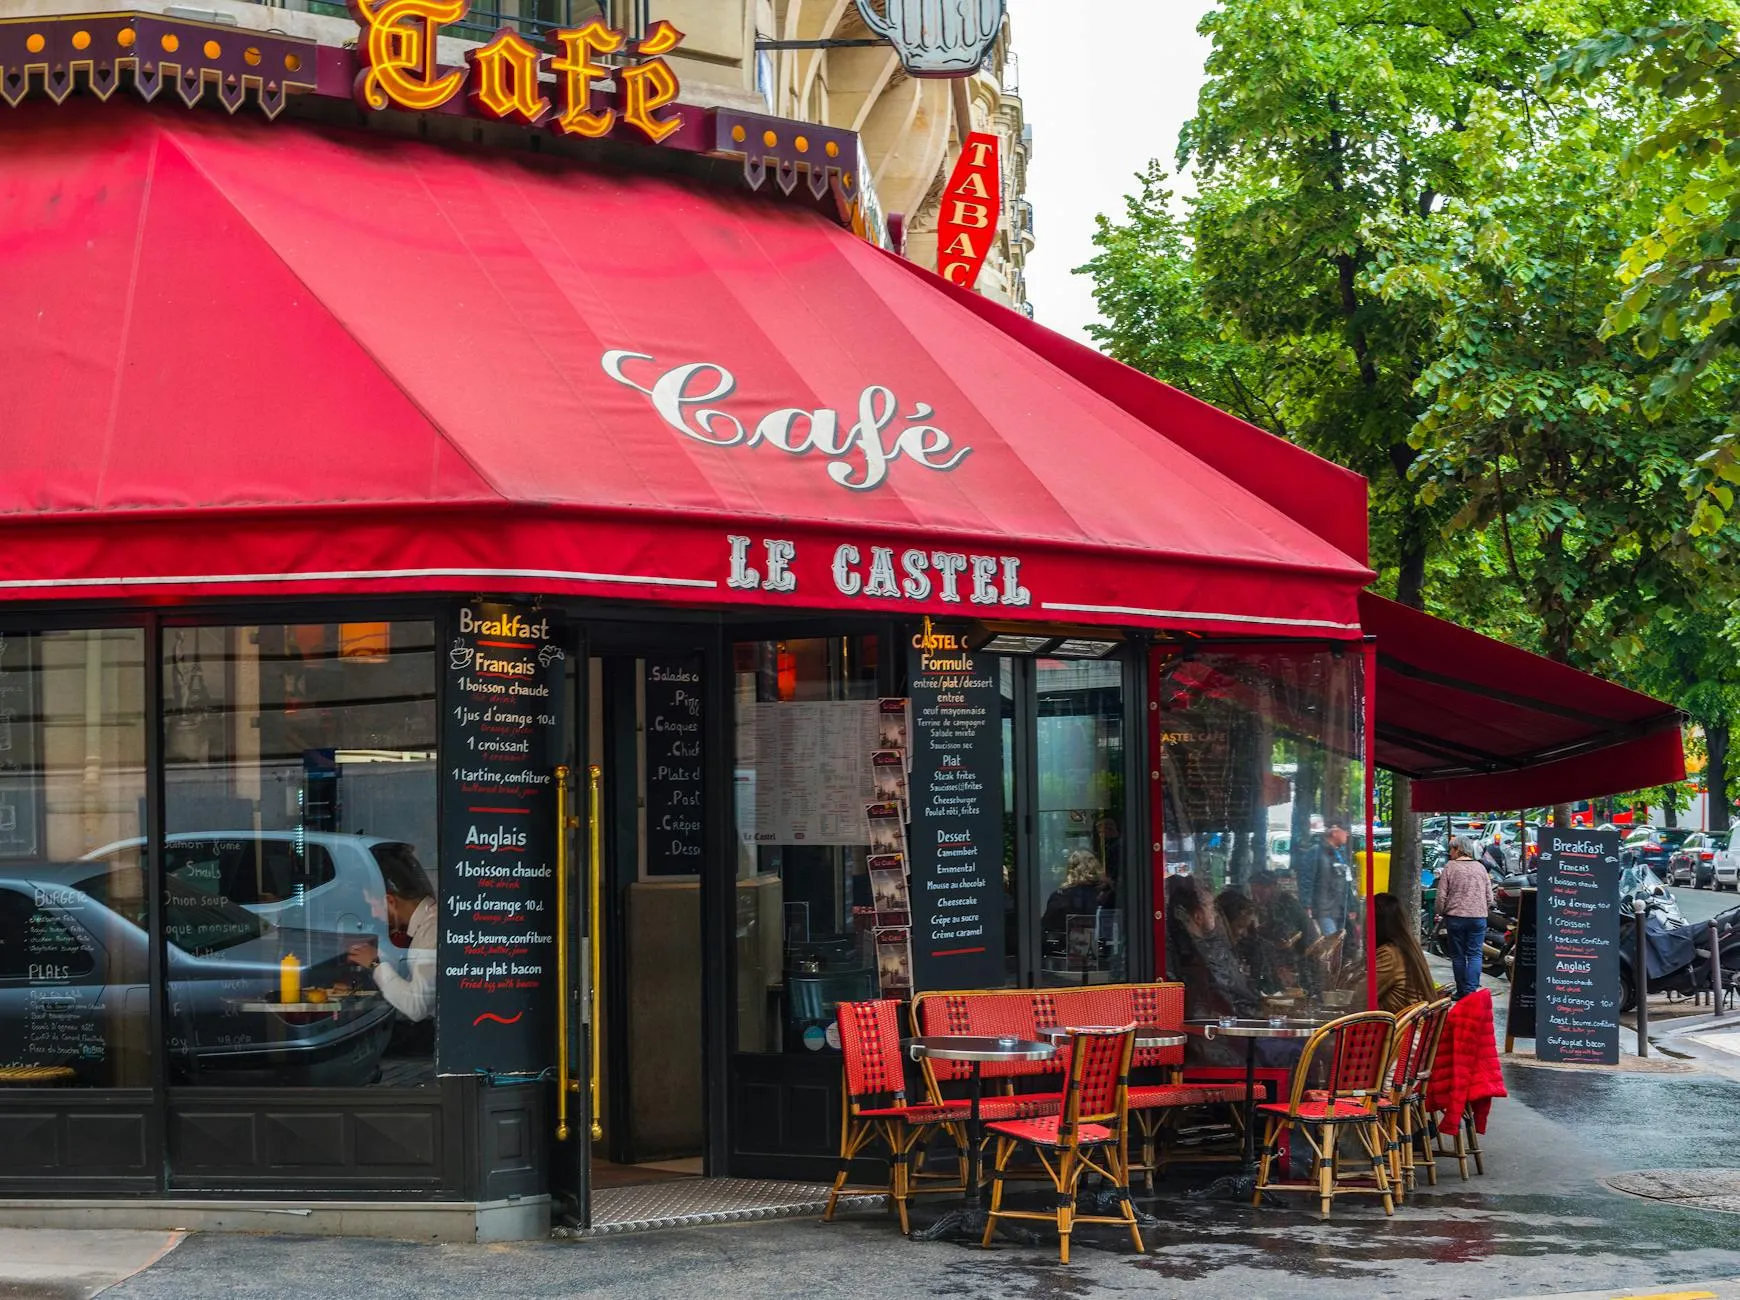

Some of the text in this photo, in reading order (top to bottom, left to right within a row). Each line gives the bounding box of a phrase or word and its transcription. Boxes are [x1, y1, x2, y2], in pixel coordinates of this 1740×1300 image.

[943, 142, 993, 287] TABAC
[601, 349, 973, 491] Café
[726, 534, 1031, 607] LE CASTEL
[460, 608, 550, 640] Breakfast
[912, 634, 958, 649] CASTEL
[475, 653, 536, 676] Français
[921, 653, 974, 671] Formule
[652, 666, 690, 681] Salades
[458, 677, 550, 697] 1 boisson chaude
[937, 692, 965, 702] entrée
[454, 706, 461, 720] 1
[461, 707, 480, 726] jus
[483, 706, 533, 728] d'orange
[940, 706, 986, 717] mayonnaise
[917, 718, 986, 729] Terrine de campagne
[930, 728, 953, 737] Salade
[467, 736, 530, 753] 1 croissant
[930, 740, 961, 750] Saucisson
[942, 754, 961, 766] Plat
[452, 768, 459, 780] 1
[934, 770, 976, 780] Steak frites
[933, 795, 977, 806] Cheeseburger
[925, 808, 946, 817] Poulet
[961, 805, 980, 815] frites
[465, 825, 527, 853] Anglais
[937, 829, 971, 843] Dessert
[937, 846, 978, 857] Camembert
[1553, 838, 1605, 854] Breakfast
[455, 860, 552, 877] 1 boisson chaude
[937, 862, 976, 874] Emmental
[926, 881, 949, 890] Mousse
[959, 878, 986, 888] chocolat
[1554, 876, 1577, 887] boisson
[200, 896, 229, 908] soup
[447, 896, 454, 910] 1
[453, 896, 472, 917] jus
[473, 893, 522, 917] d'orange
[937, 896, 978, 907] Cheesecake
[1553, 896, 1566, 908] jus
[931, 915, 951, 927] Crêpe
[932, 925, 983, 939] Crème caramel
[470, 967, 484, 975] au
[486, 961, 508, 981] plat
[511, 963, 542, 975] bacon
[1556, 961, 1591, 973] Anglais
[1586, 1039, 1605, 1047] bacon
